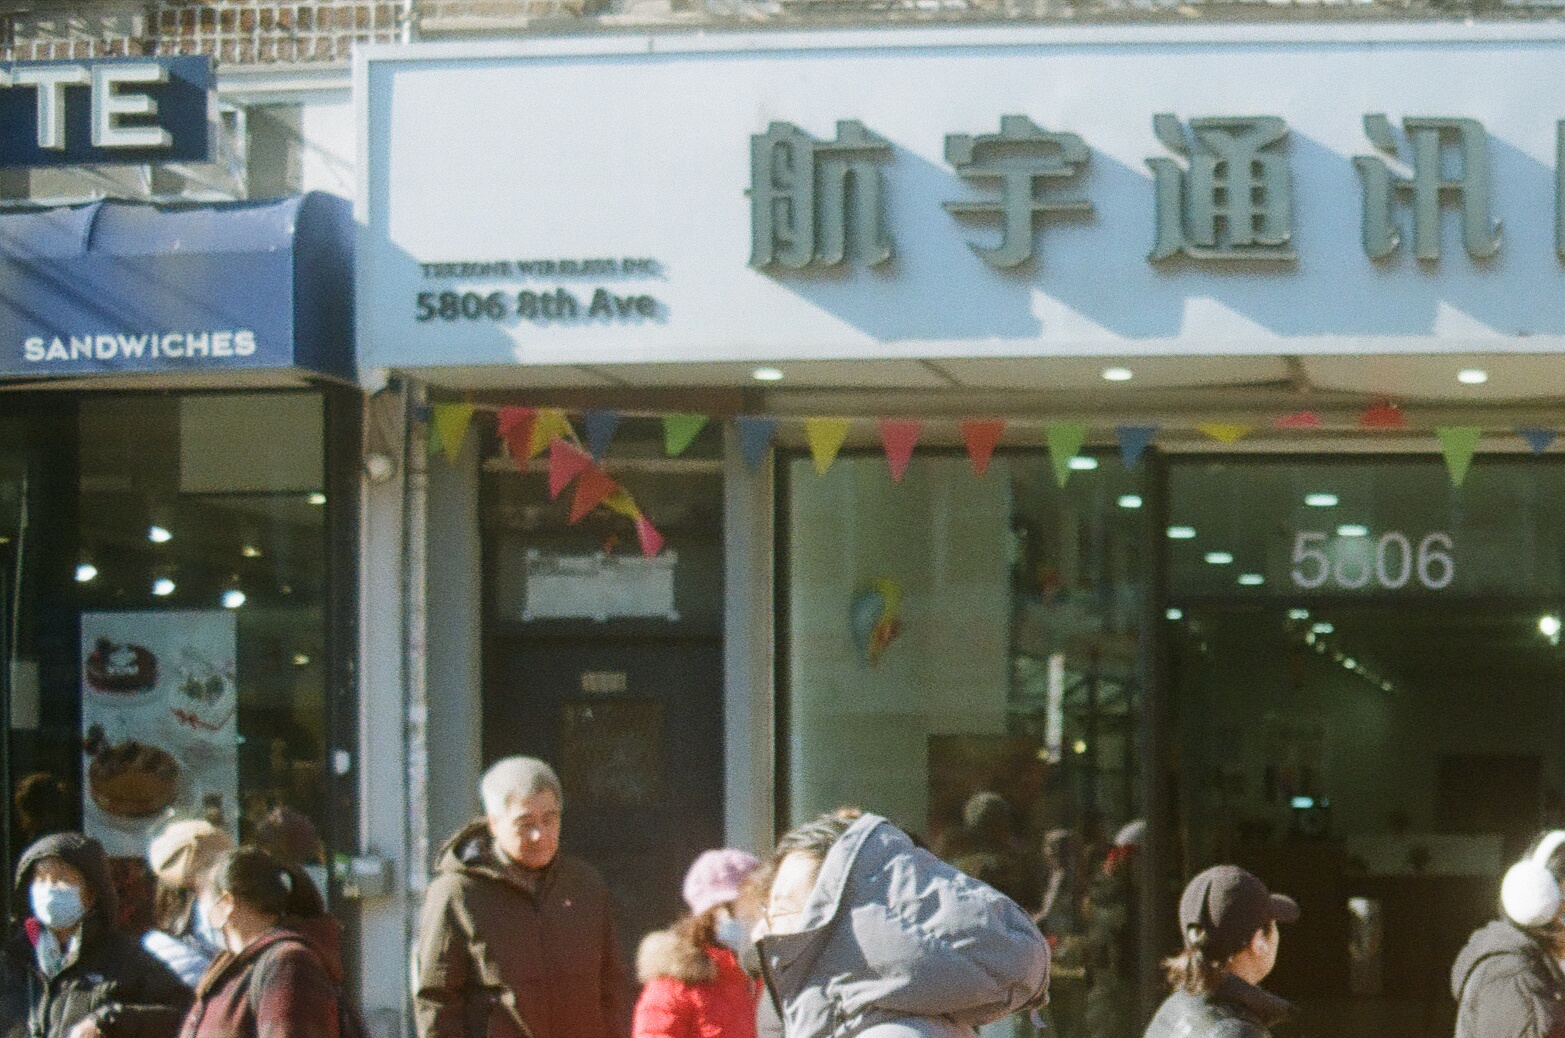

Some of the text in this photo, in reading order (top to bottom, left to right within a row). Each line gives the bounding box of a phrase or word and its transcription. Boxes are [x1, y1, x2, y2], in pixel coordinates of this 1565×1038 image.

[0, 62, 173, 150] TE
[745, 113, 1504, 268] 航宇通讯
[415, 287, 656, 322] 5806 8th Ave
[24, 329, 256, 361] SANDWICHES
